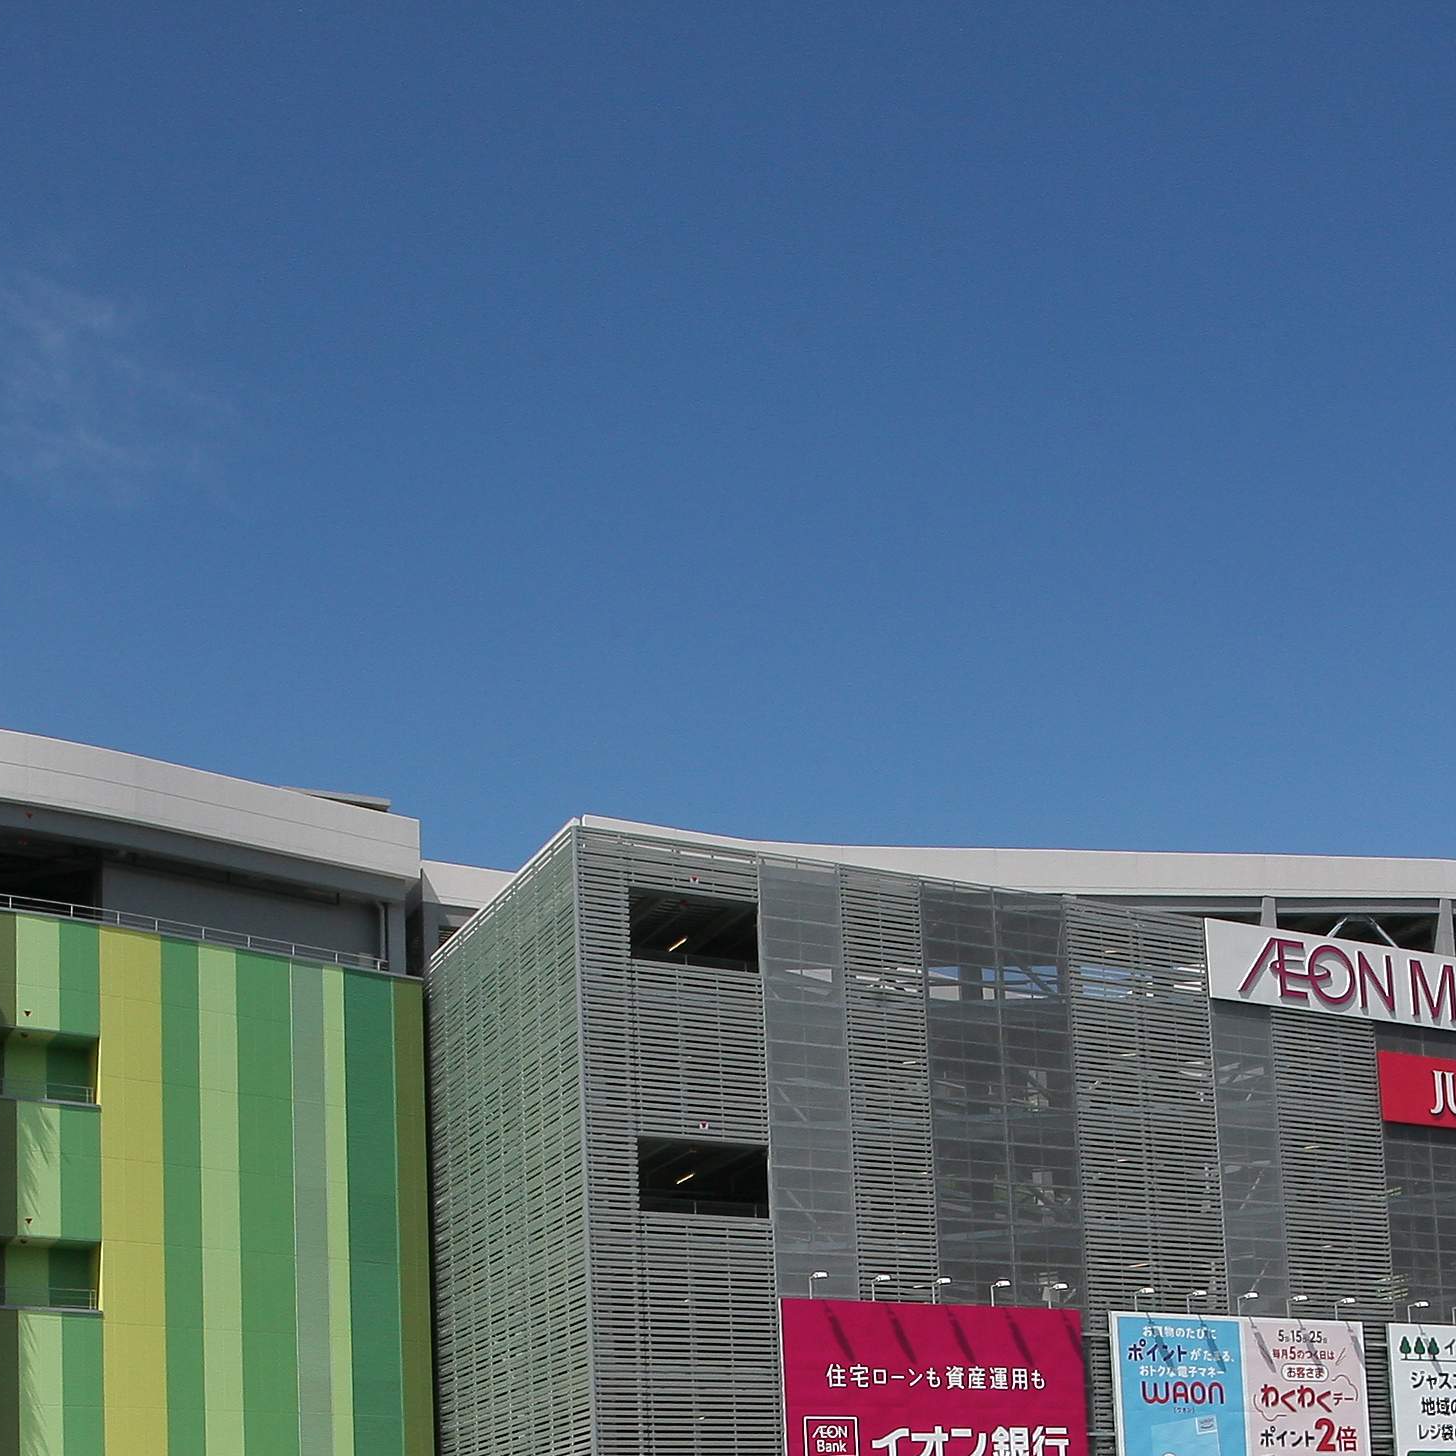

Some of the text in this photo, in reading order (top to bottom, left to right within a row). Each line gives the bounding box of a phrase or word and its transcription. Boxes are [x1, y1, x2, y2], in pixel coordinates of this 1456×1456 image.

[826, 1363, 1046, 1390] 住宅ローンも資産運用も
[1287, 1367, 1324, 1379] お客さま
[1141, 1380, 1225, 1406] WAON
[816, 1439, 847, 1452] Bank
[1260, 1417, 1357, 1453] ポイント2倍
